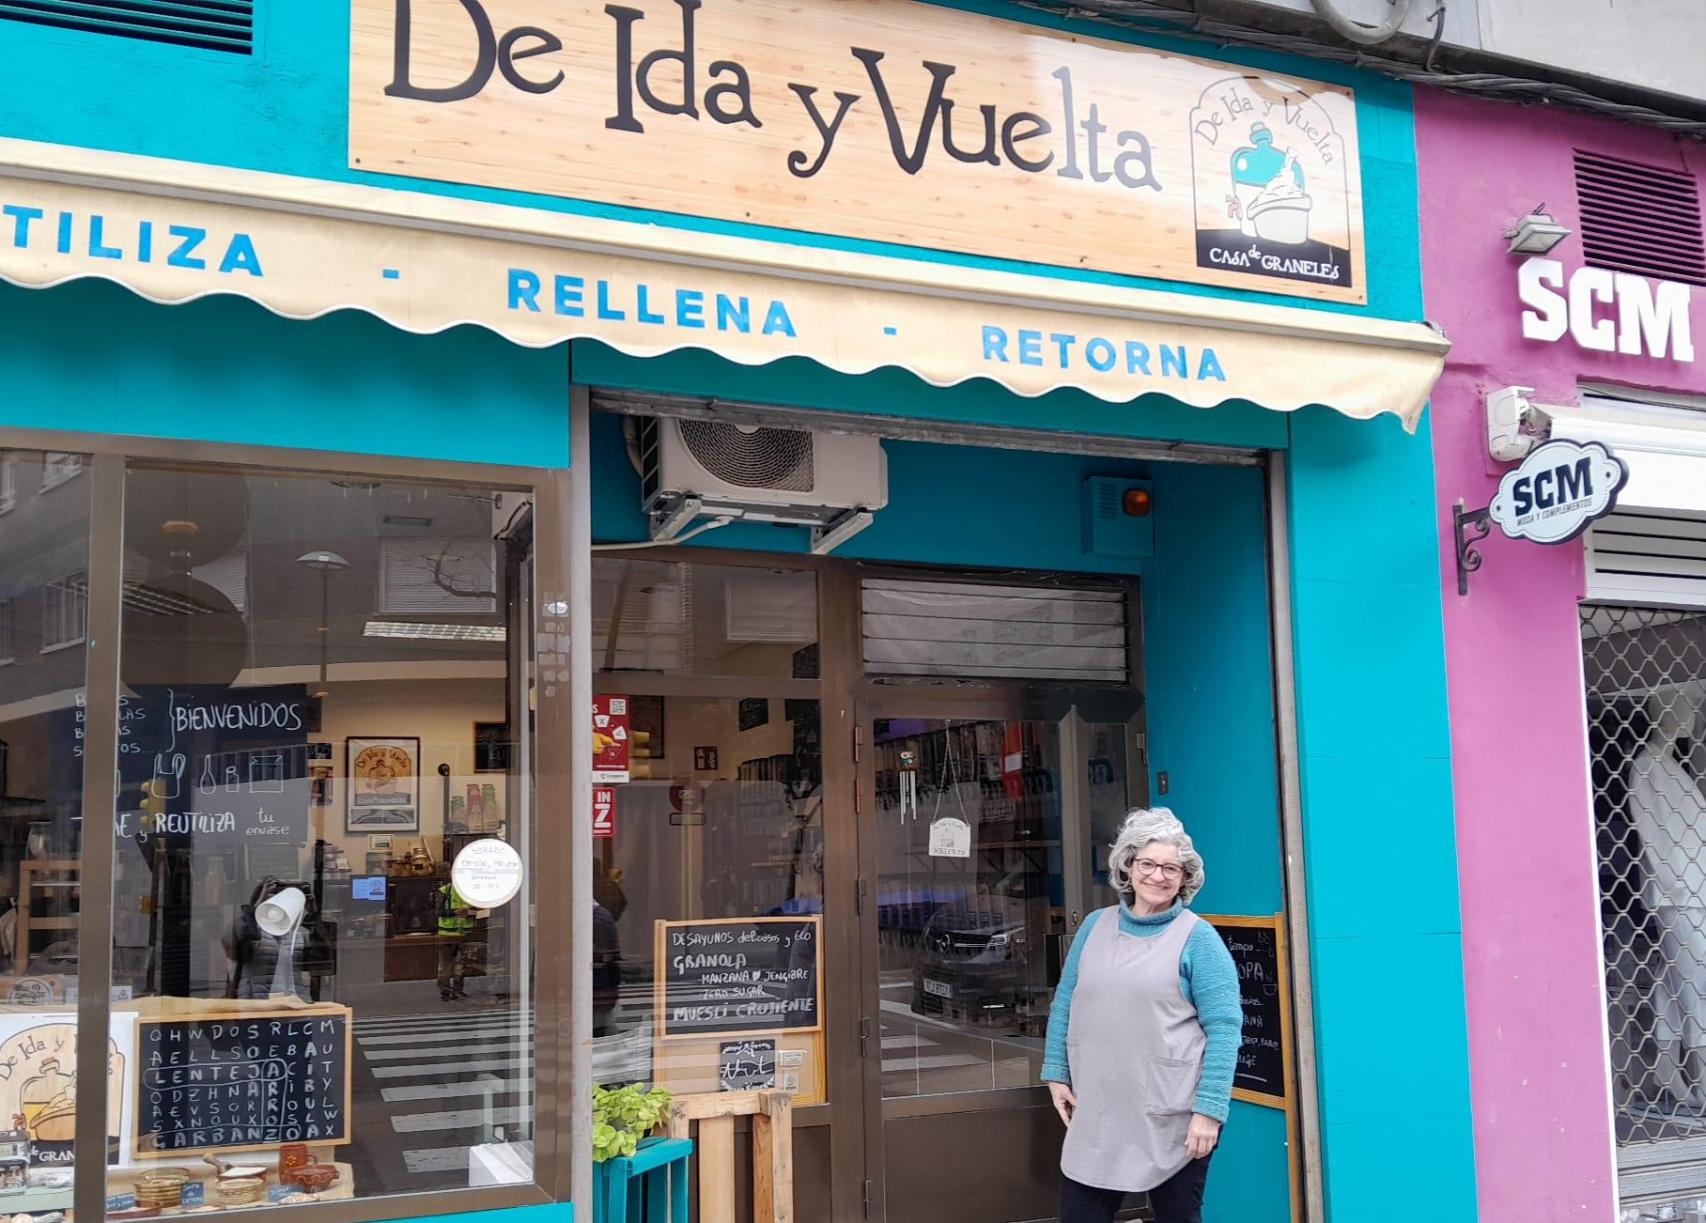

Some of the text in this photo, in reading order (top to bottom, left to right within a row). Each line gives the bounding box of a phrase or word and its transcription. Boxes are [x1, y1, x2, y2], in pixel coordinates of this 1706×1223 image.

[383, 0, 1163, 191] De Ida y Vuelta
[1194, 87, 1334, 166] De Ida y Vuelta
[1209, 245, 1340, 279] CASA de GRANELES
[3, 203, 263, 277] TILIZA
[508, 269, 797, 338] RELLENA
[982, 326, 1227, 383] RETORNA
[1518, 261, 1695, 363] SCM
[1513, 457, 1594, 517] SCM
[1517, 514, 1535, 526] MODA
[1541, 498, 1593, 520] COMPLEMENTOS
[245, 825, 290, 835] envase
[672, 931, 733, 946] DESAYUNOS
[673, 953, 747, 975] GRANOLA
[736, 998, 815, 1018] CRUJIENTE
